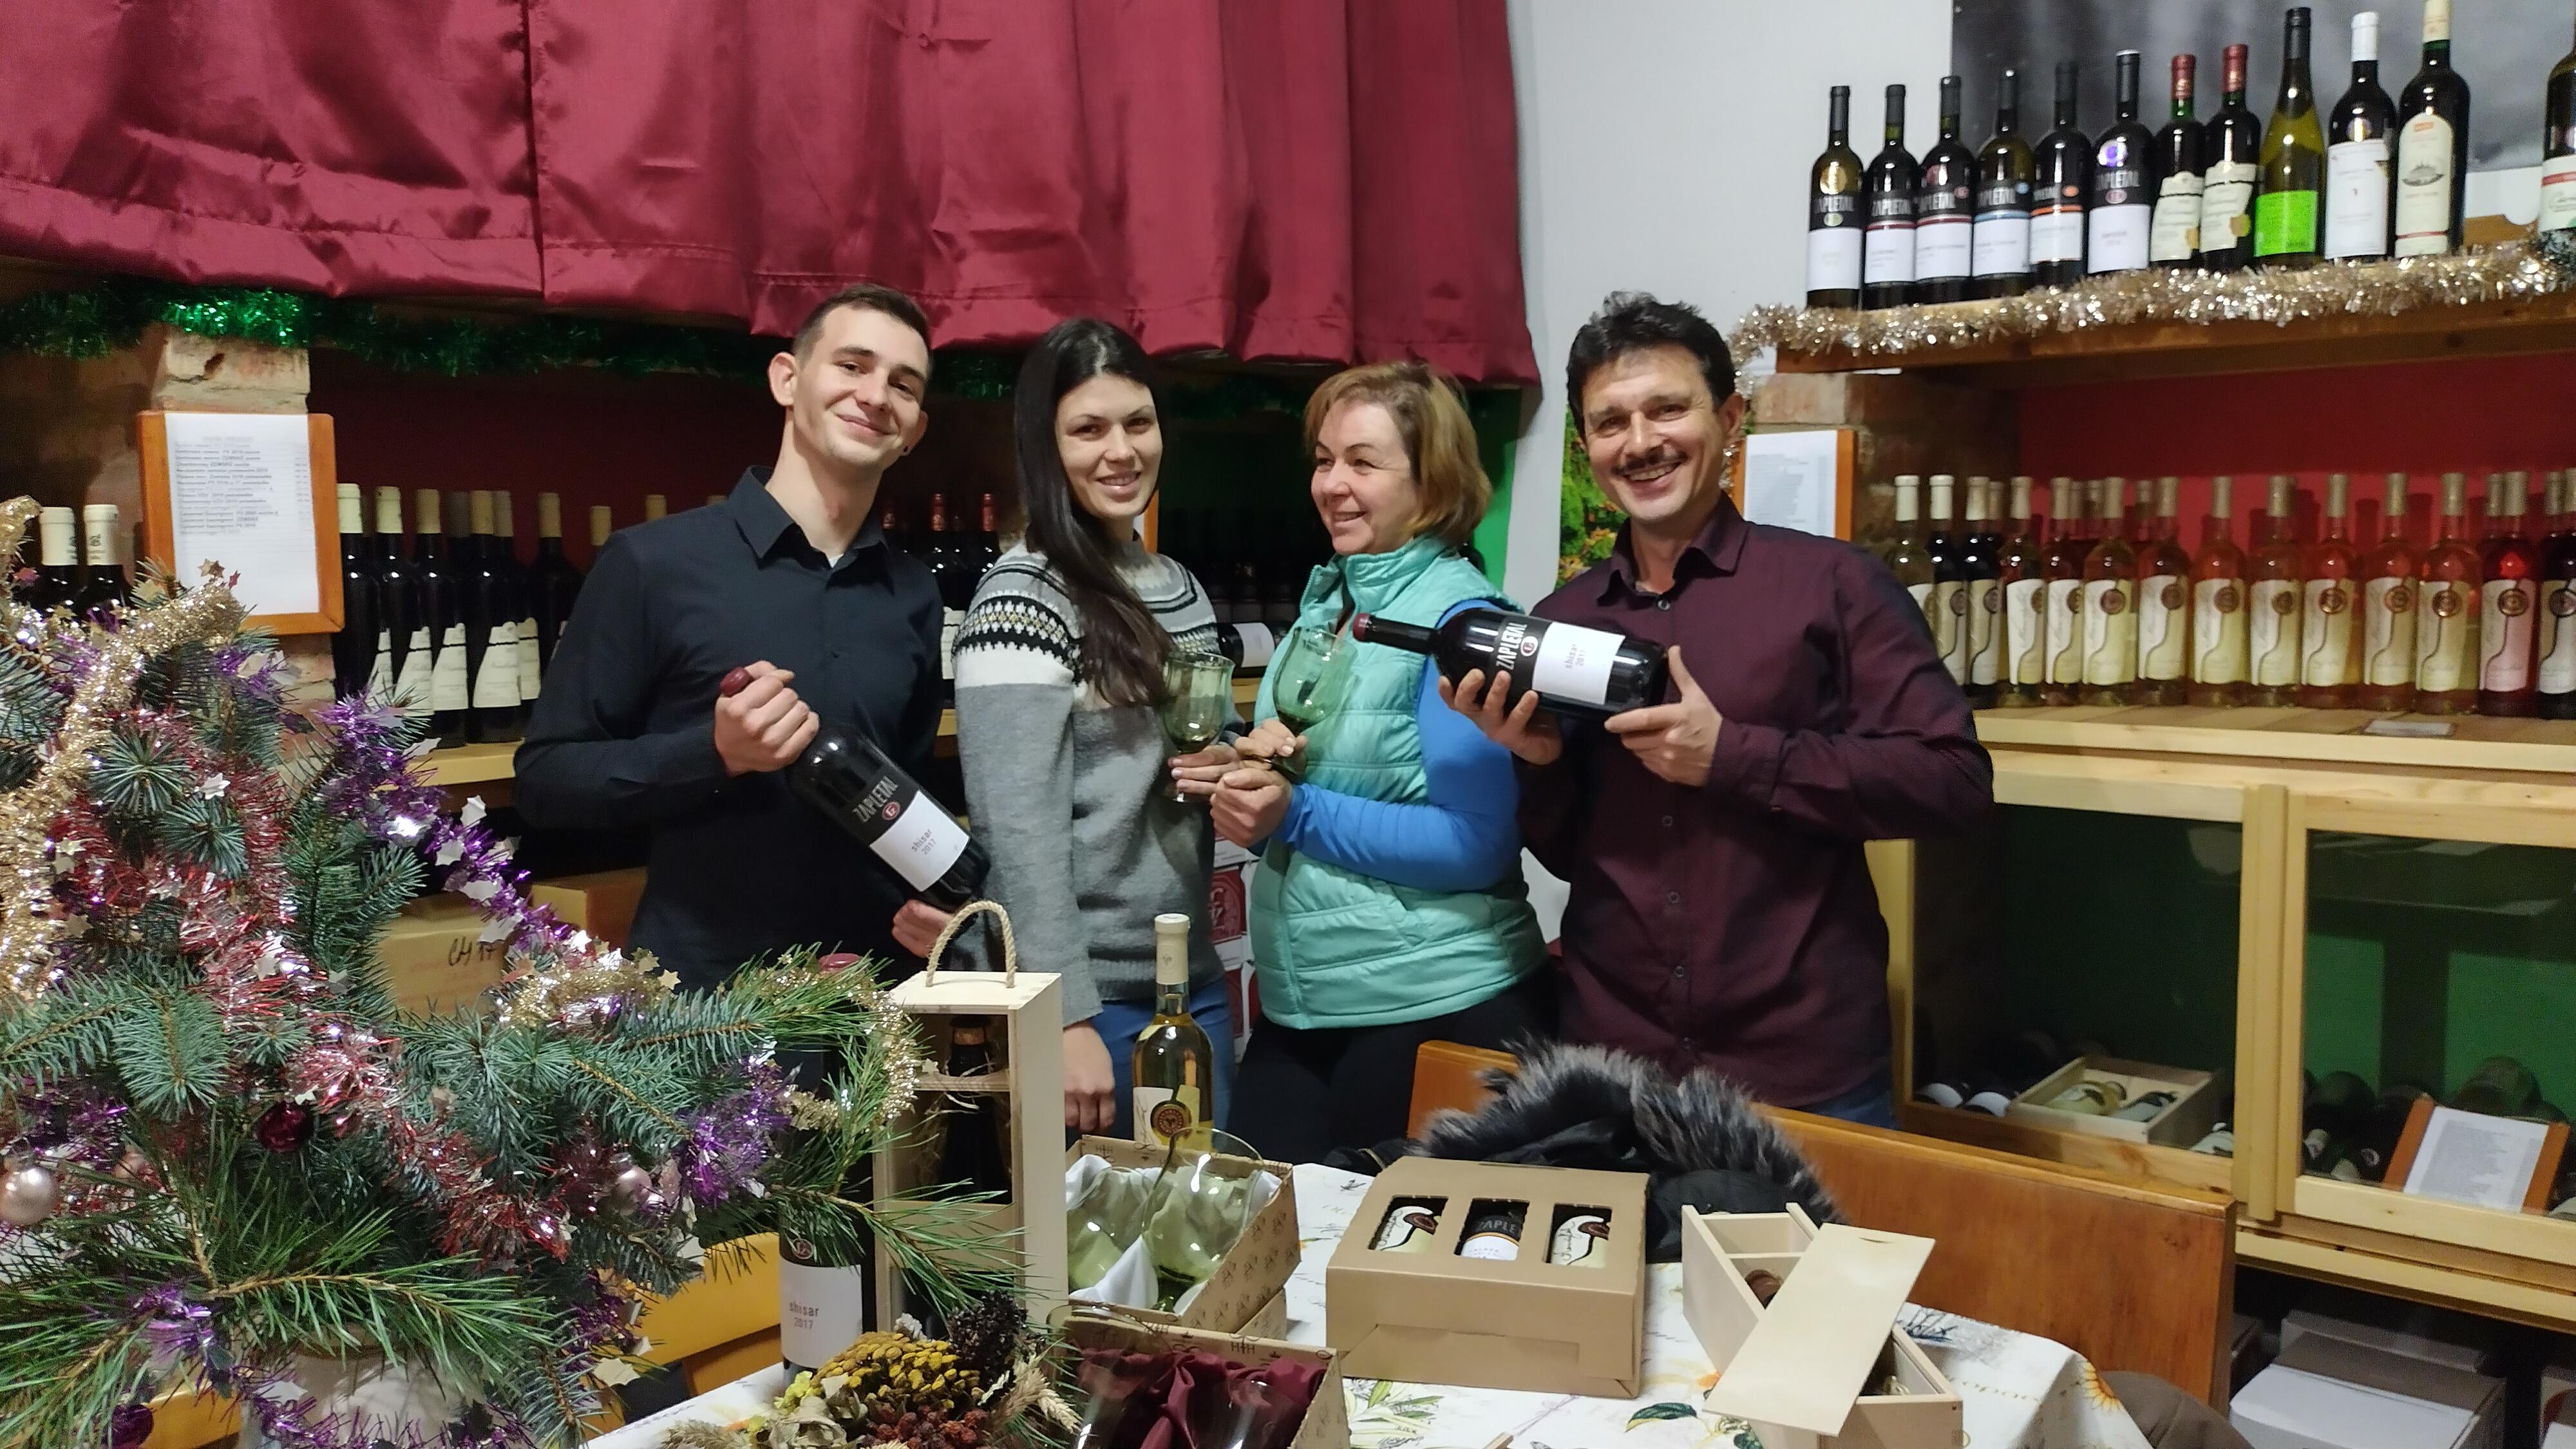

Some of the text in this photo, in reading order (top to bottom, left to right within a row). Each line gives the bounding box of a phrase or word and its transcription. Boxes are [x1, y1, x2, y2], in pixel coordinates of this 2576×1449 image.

[1496, 622, 1528, 670] ZAPLETAL
[852, 775, 900, 822] ZAPLETAL
[911, 828, 933, 852] shisar
[922, 838, 936, 855] 2017
[789, 1301, 819, 1317] shisar
[794, 1317, 814, 1330] 2017
